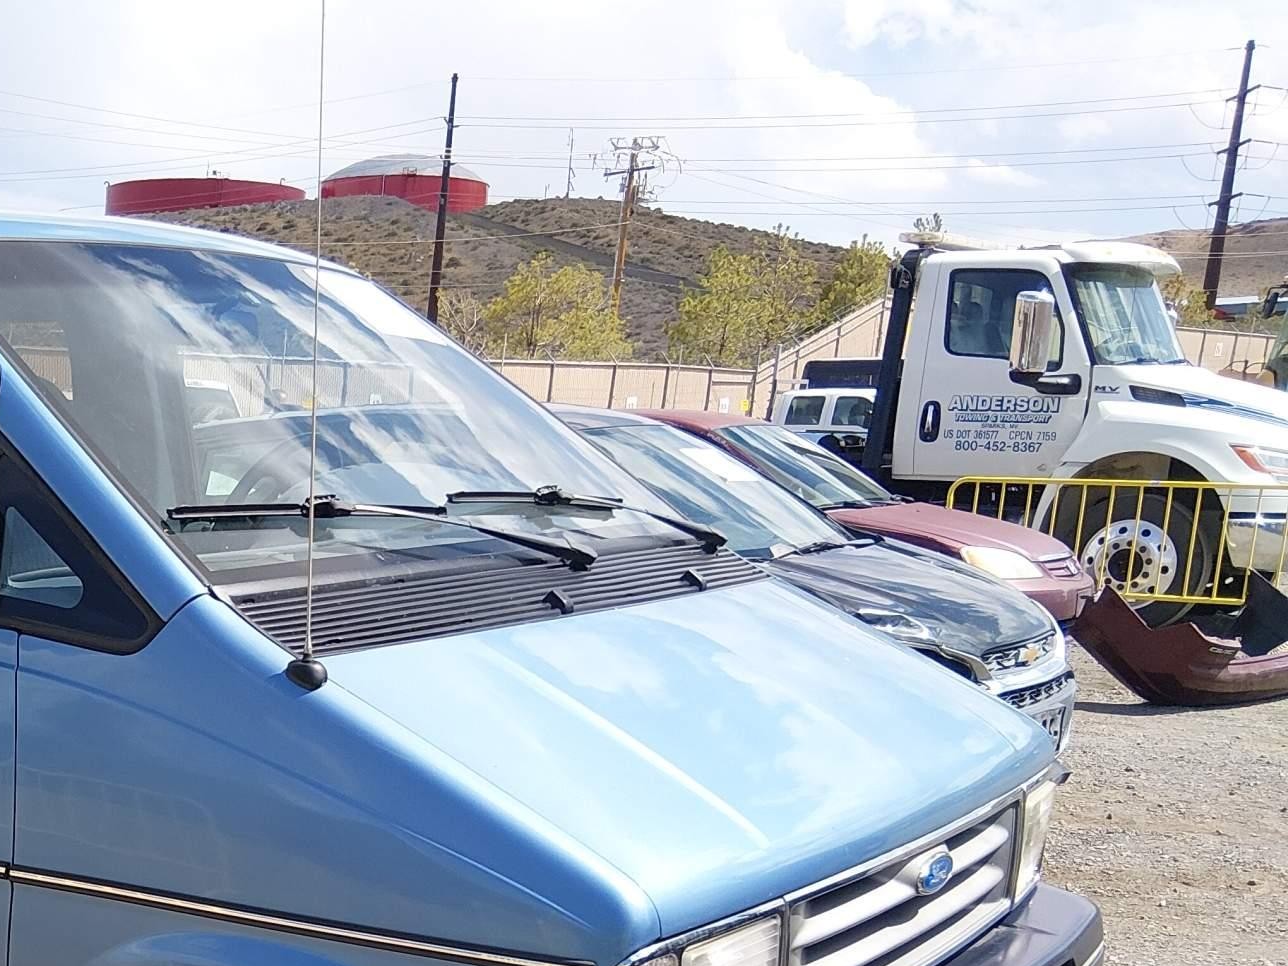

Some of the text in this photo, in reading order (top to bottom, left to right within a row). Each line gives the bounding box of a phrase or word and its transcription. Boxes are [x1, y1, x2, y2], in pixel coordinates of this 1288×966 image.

[948, 395, 1061, 413] ANDERSON
[955, 413, 1052, 424] TOWING & TRANSPORT
[943, 430, 1057, 442] US DOT 361577 CPCN 7159
[954, 440, 1042, 453] 800-452-8367
